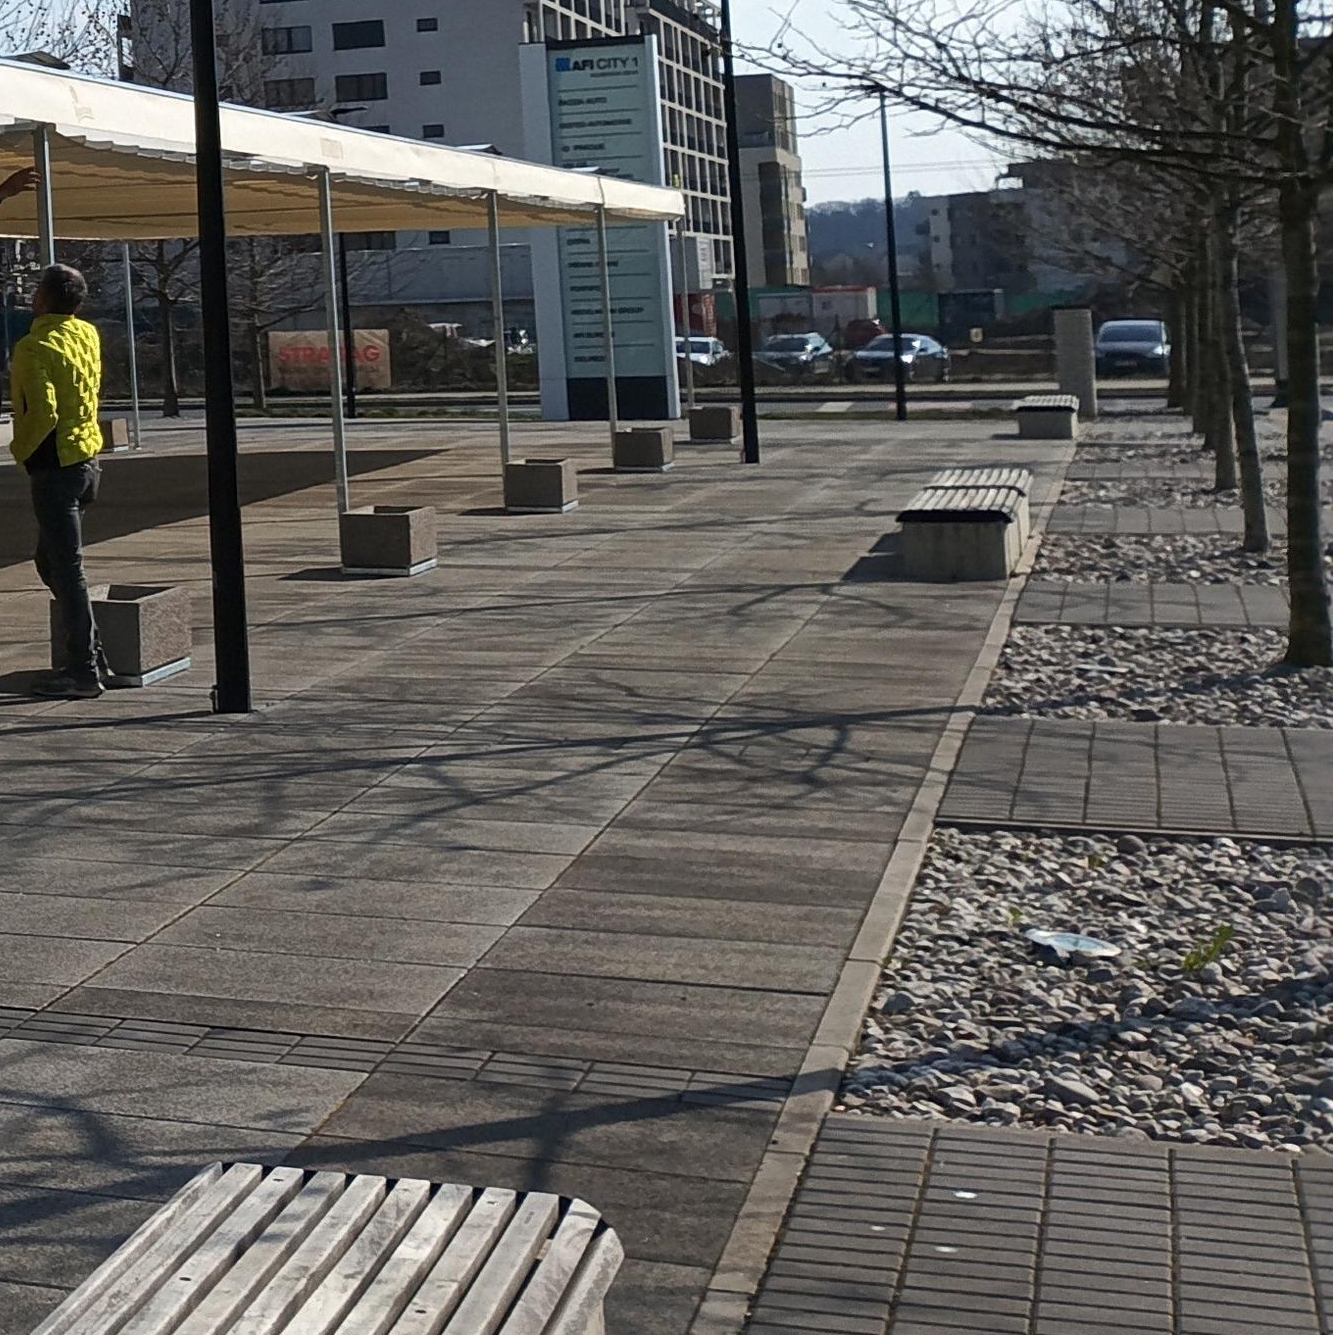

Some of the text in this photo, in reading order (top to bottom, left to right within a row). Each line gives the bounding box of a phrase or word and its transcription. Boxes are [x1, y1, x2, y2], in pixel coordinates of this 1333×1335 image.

[572, 59, 594, 72] AFI
[596, 57, 629, 70] CITY
[279, 345, 380, 362] STRAAG
